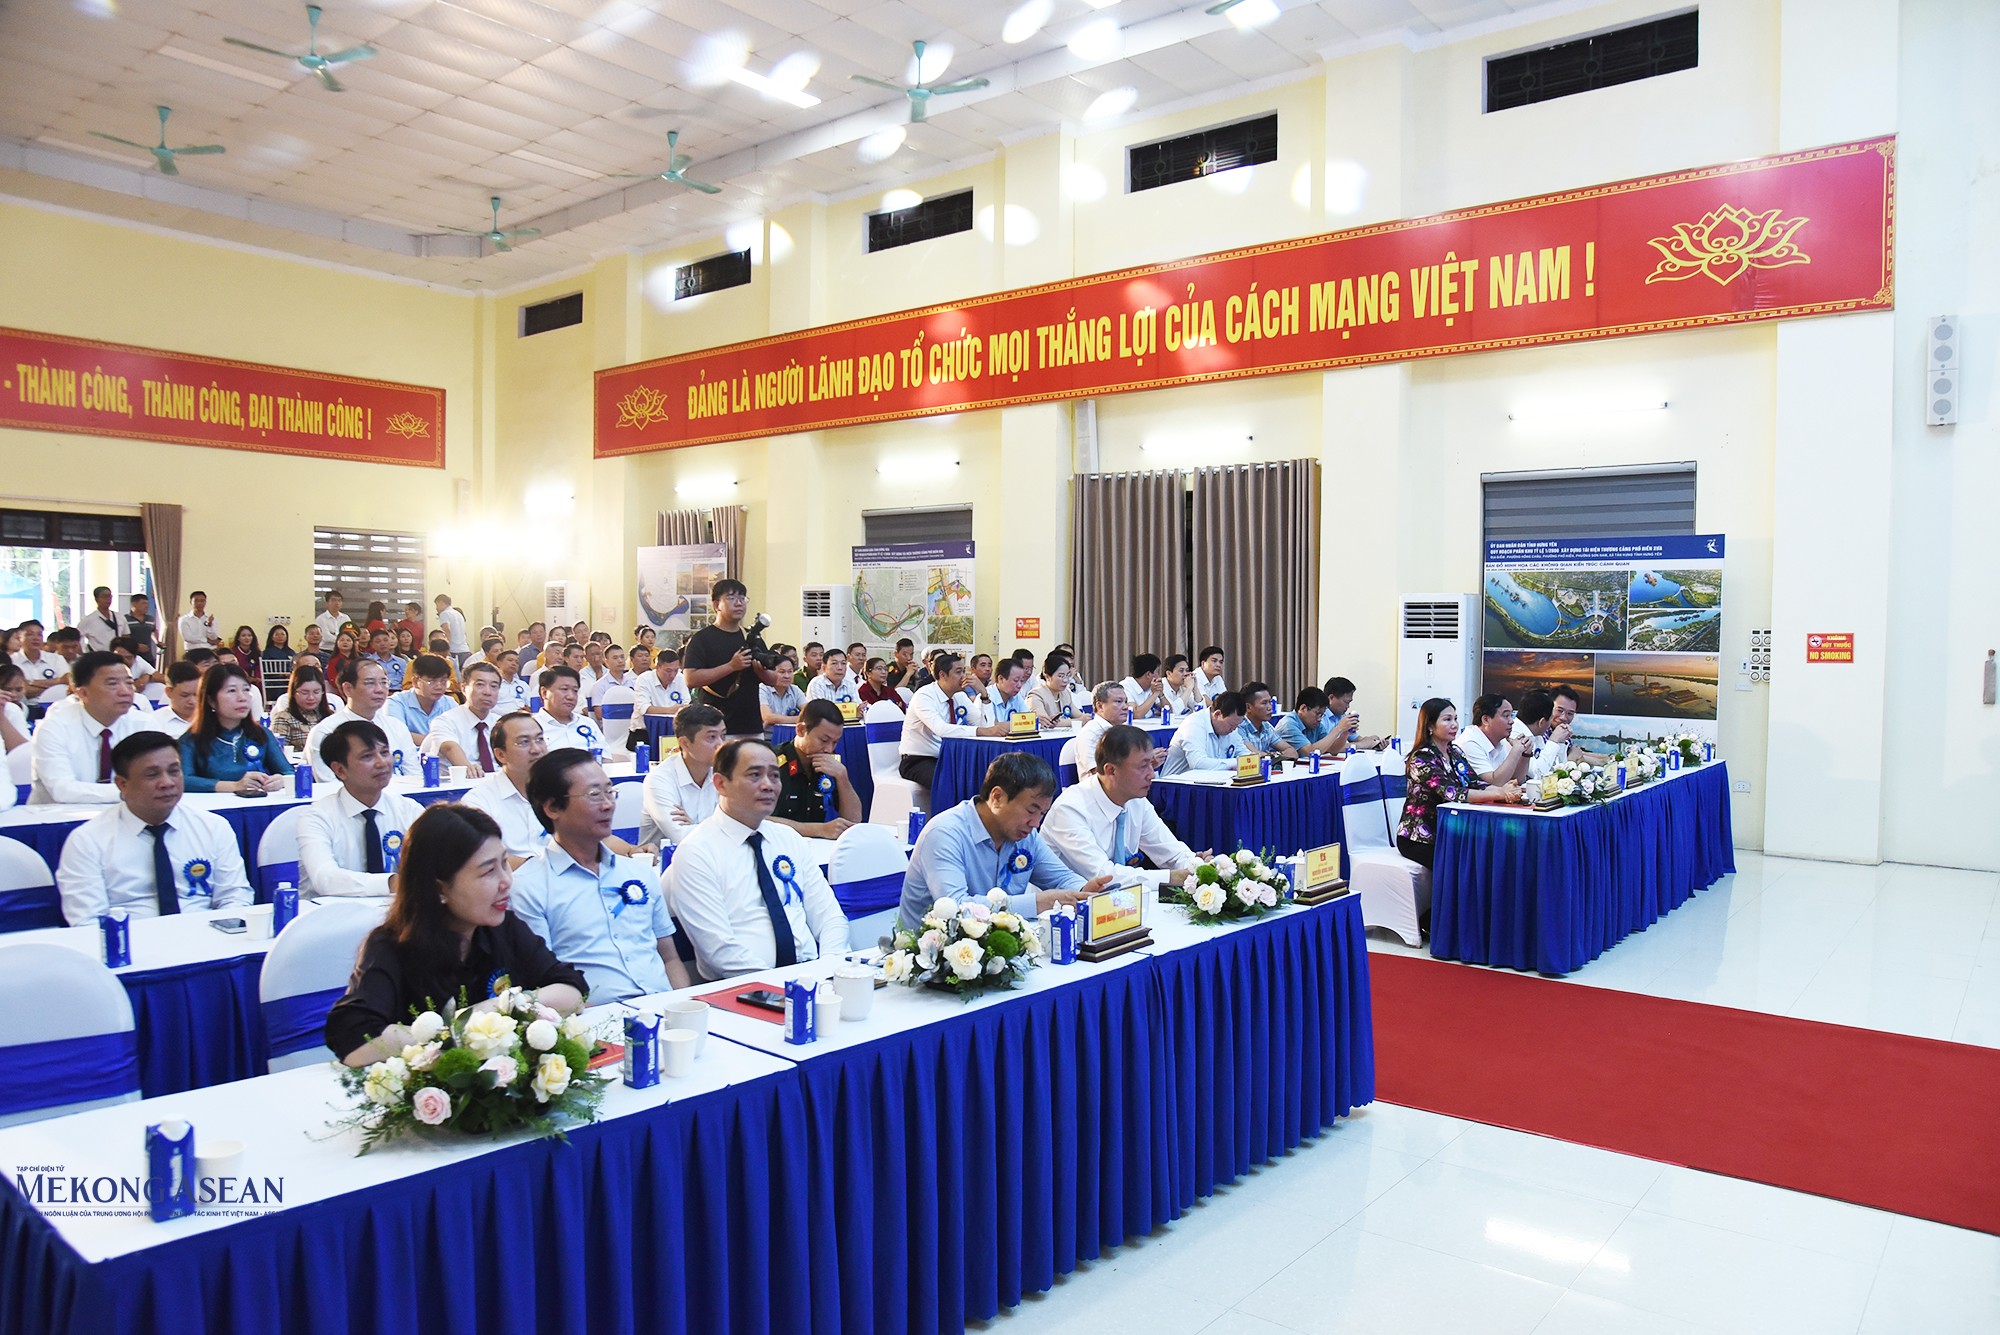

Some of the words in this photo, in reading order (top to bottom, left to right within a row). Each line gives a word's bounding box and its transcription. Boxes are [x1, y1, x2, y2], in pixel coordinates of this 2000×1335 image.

[688, 369, 728, 421] ĐẢNG
[732, 371, 751, 413] LÀ
[755, 358, 803, 410] NGƯỜI
[808, 355, 853, 402] LÃNH
[858, 352, 895, 401] ĐẠO
[901, 330, 924, 389] TỔ
[929, 327, 982, 385] CHỨC
[988, 329, 1029, 383] MỌI
[1037, 307, 1111, 369] THẮNG
[1118, 305, 1157, 367] LỢI
[1164, 282, 1217, 352] CỦA
[1225, 282, 1299, 345] CÁCH
[1309, 271, 1400, 340] MẠNG
[1410, 251, 1480, 327] VIỆT
[1488, 245, 1571, 310] NAM
[1585, 241, 1596, 298] !
[16, 358, 76, 408] THÀNH
[81, 365, 133, 419] CÔNG,
[142, 368, 195, 421] THÀNH
[199, 381, 245, 431] CÔNG,
[248, 393, 273, 437] ĐẠI
[277, 391, 323, 436] THÀNH
[327, 397, 364, 440] CÔNG
[367, 408, 372, 440] !
